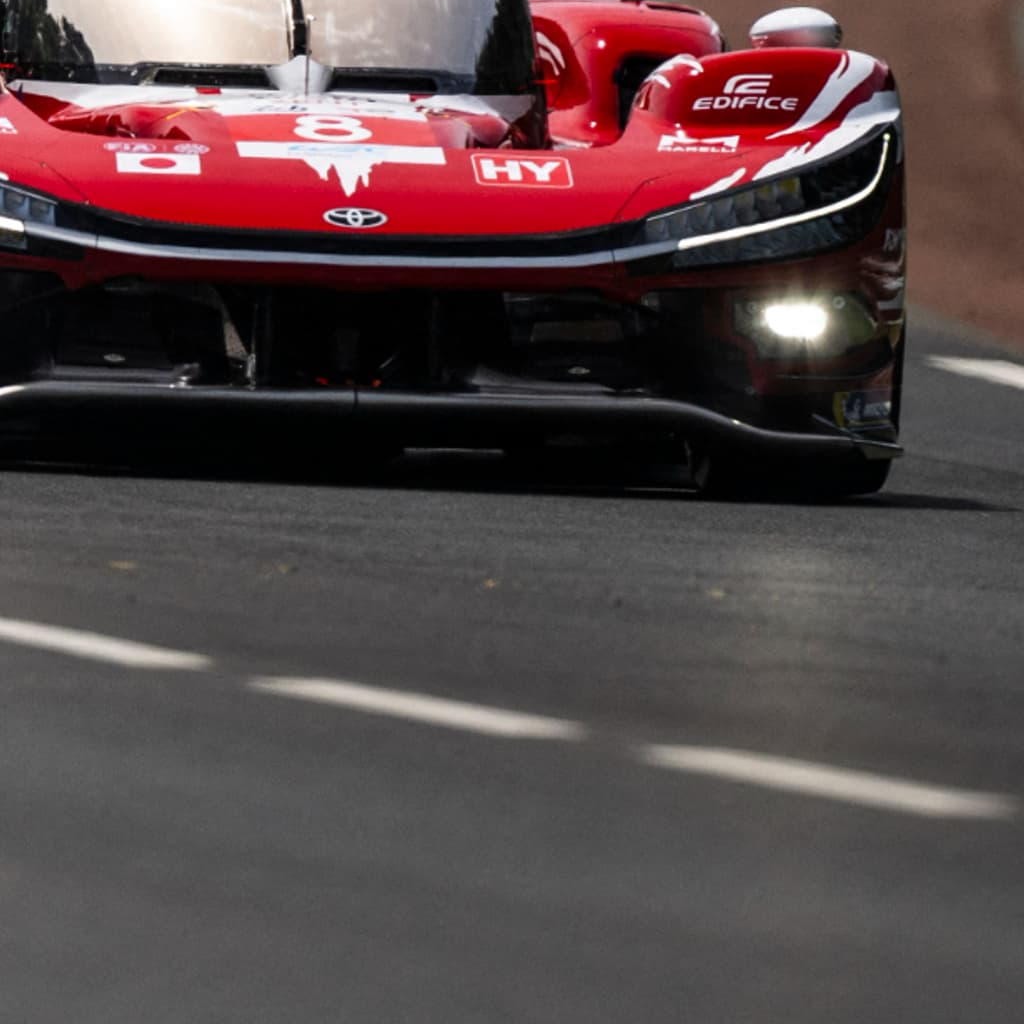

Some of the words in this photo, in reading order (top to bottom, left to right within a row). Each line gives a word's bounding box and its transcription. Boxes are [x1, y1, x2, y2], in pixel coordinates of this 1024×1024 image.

[692, 96, 799, 111] EDIFICE
[293, 114, 373, 142] 8
[480, 159, 561, 183] HY
